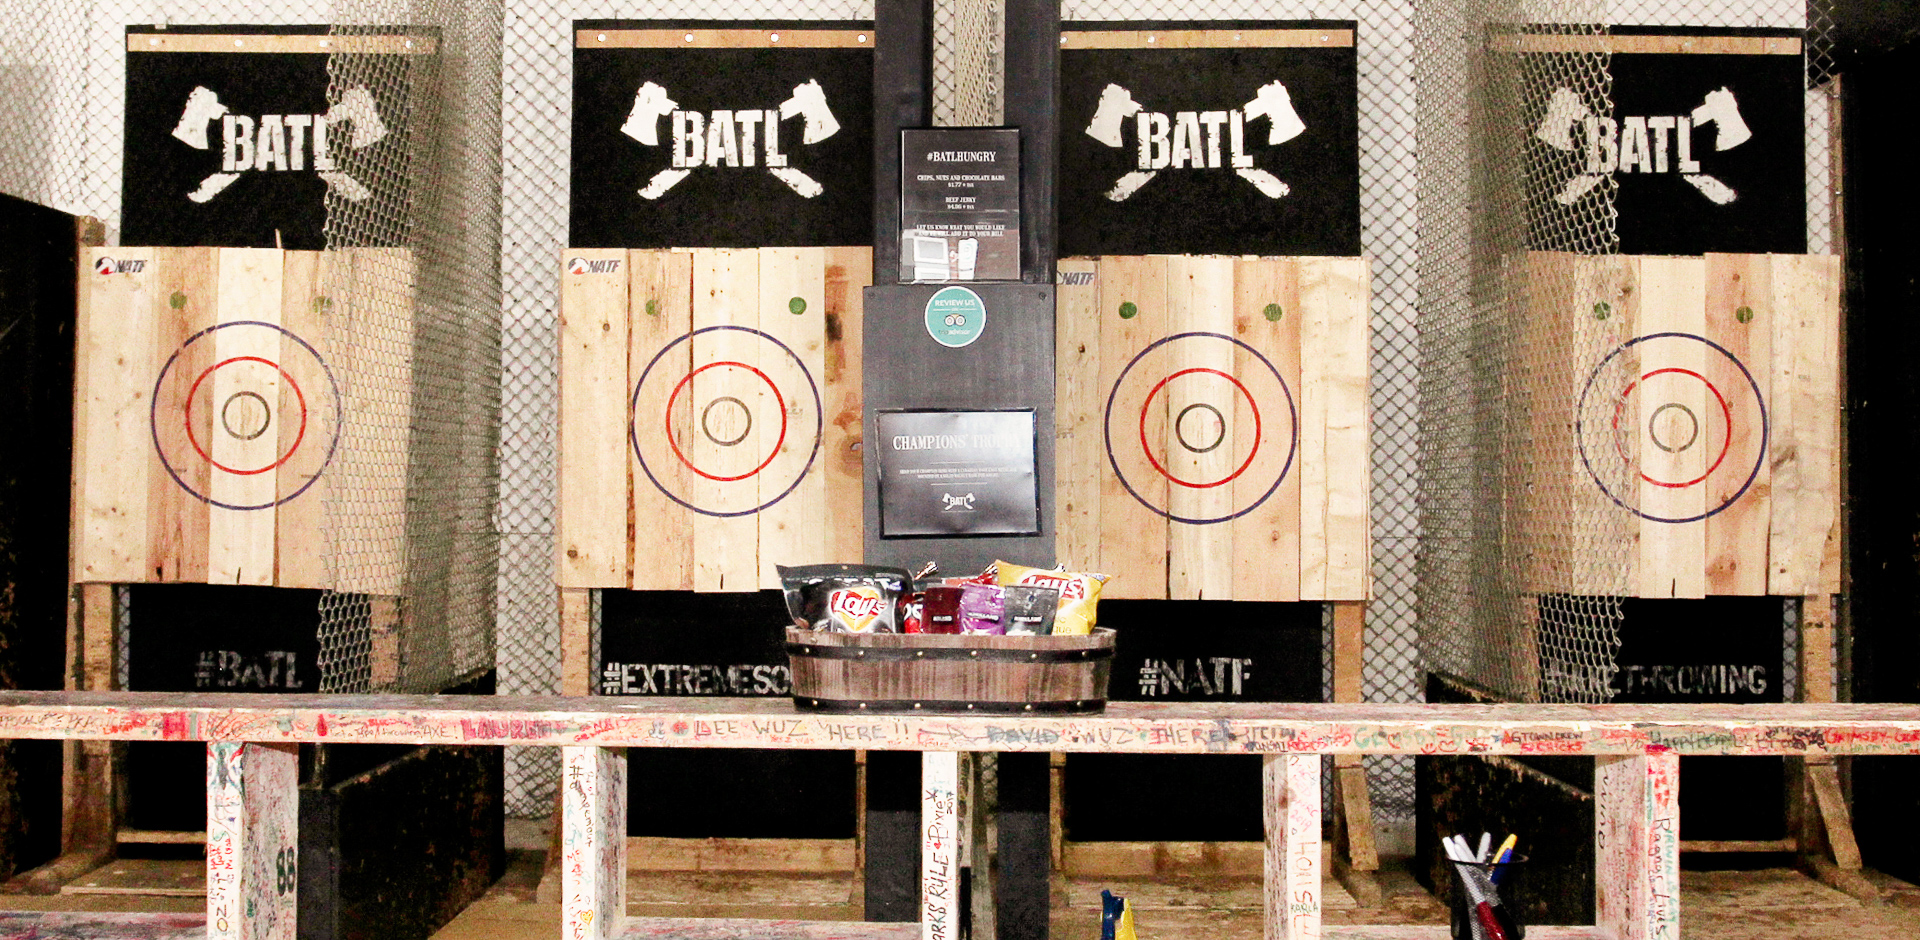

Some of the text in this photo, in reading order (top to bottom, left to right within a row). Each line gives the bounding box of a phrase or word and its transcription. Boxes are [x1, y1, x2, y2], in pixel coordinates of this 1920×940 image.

[222, 114, 335, 171] BATL
[672, 110, 788, 167] BATL
[1137, 109, 1253, 169] BATL
[1586, 116, 1700, 173] BATL
[927, 151, 996, 162] #BATLHUNGRY
[589, 260, 621, 273] NATF
[1063, 272, 1094, 285] NATF
[893, 434, 969, 450] CHAMPIONS'
[950, 496, 967, 506] BATL
[195, 650, 303, 688] #BATL
[1139, 657, 1252, 696] #NATF
[752, 720, 808, 737] WUZ
[829, 724, 887, 743] HERE
